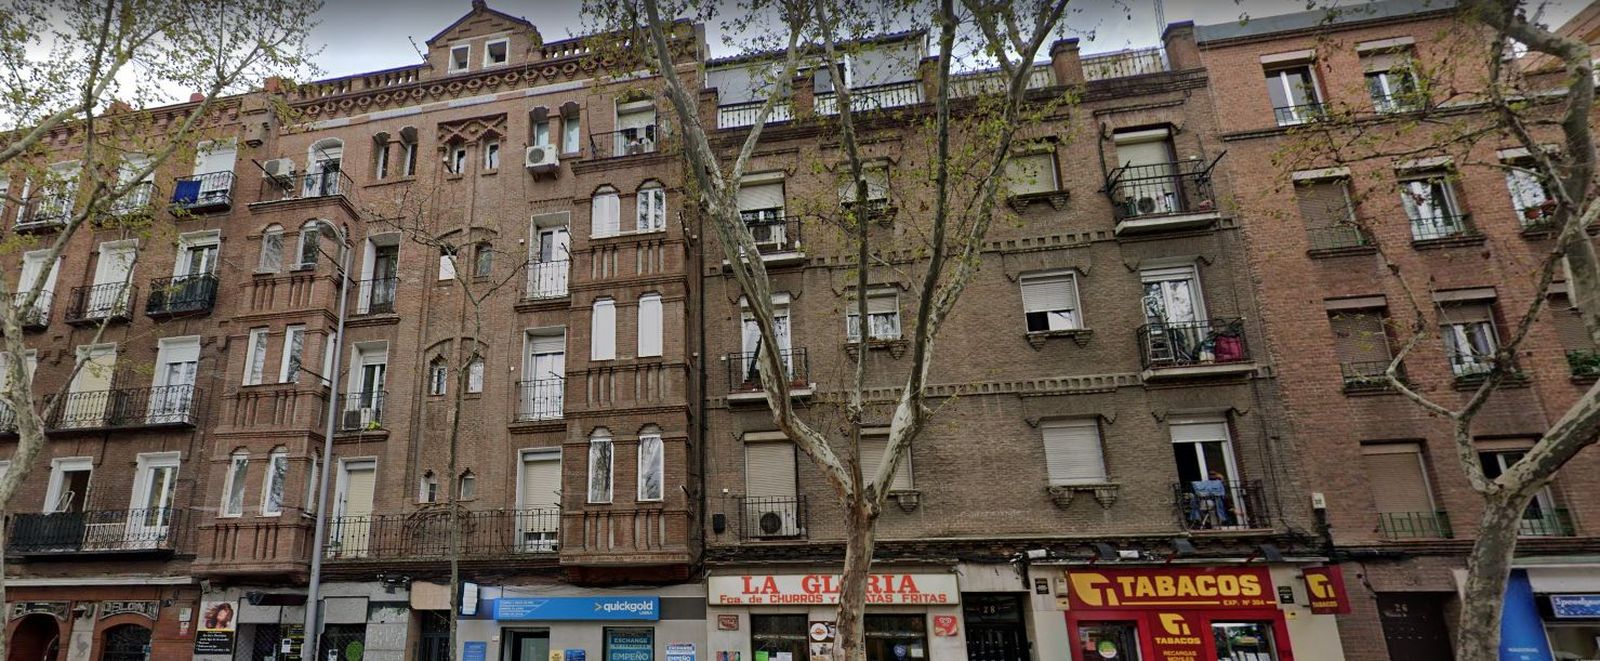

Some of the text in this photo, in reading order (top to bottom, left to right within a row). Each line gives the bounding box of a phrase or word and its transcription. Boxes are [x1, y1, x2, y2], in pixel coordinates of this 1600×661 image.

[742, 575, 920, 594] LA GLRIA
[1117, 575, 1262, 597] TABACOS
[719, 594, 743, 604] Fca.
[748, 595, 762, 604] de
[769, 594, 823, 604] CHURROS
[901, 594, 947, 604] FRITAS
[603, 600, 653, 613] quickgold
[1154, 637, 1201, 645] TABACOS
[612, 651, 648, 661] EMPEÑO
